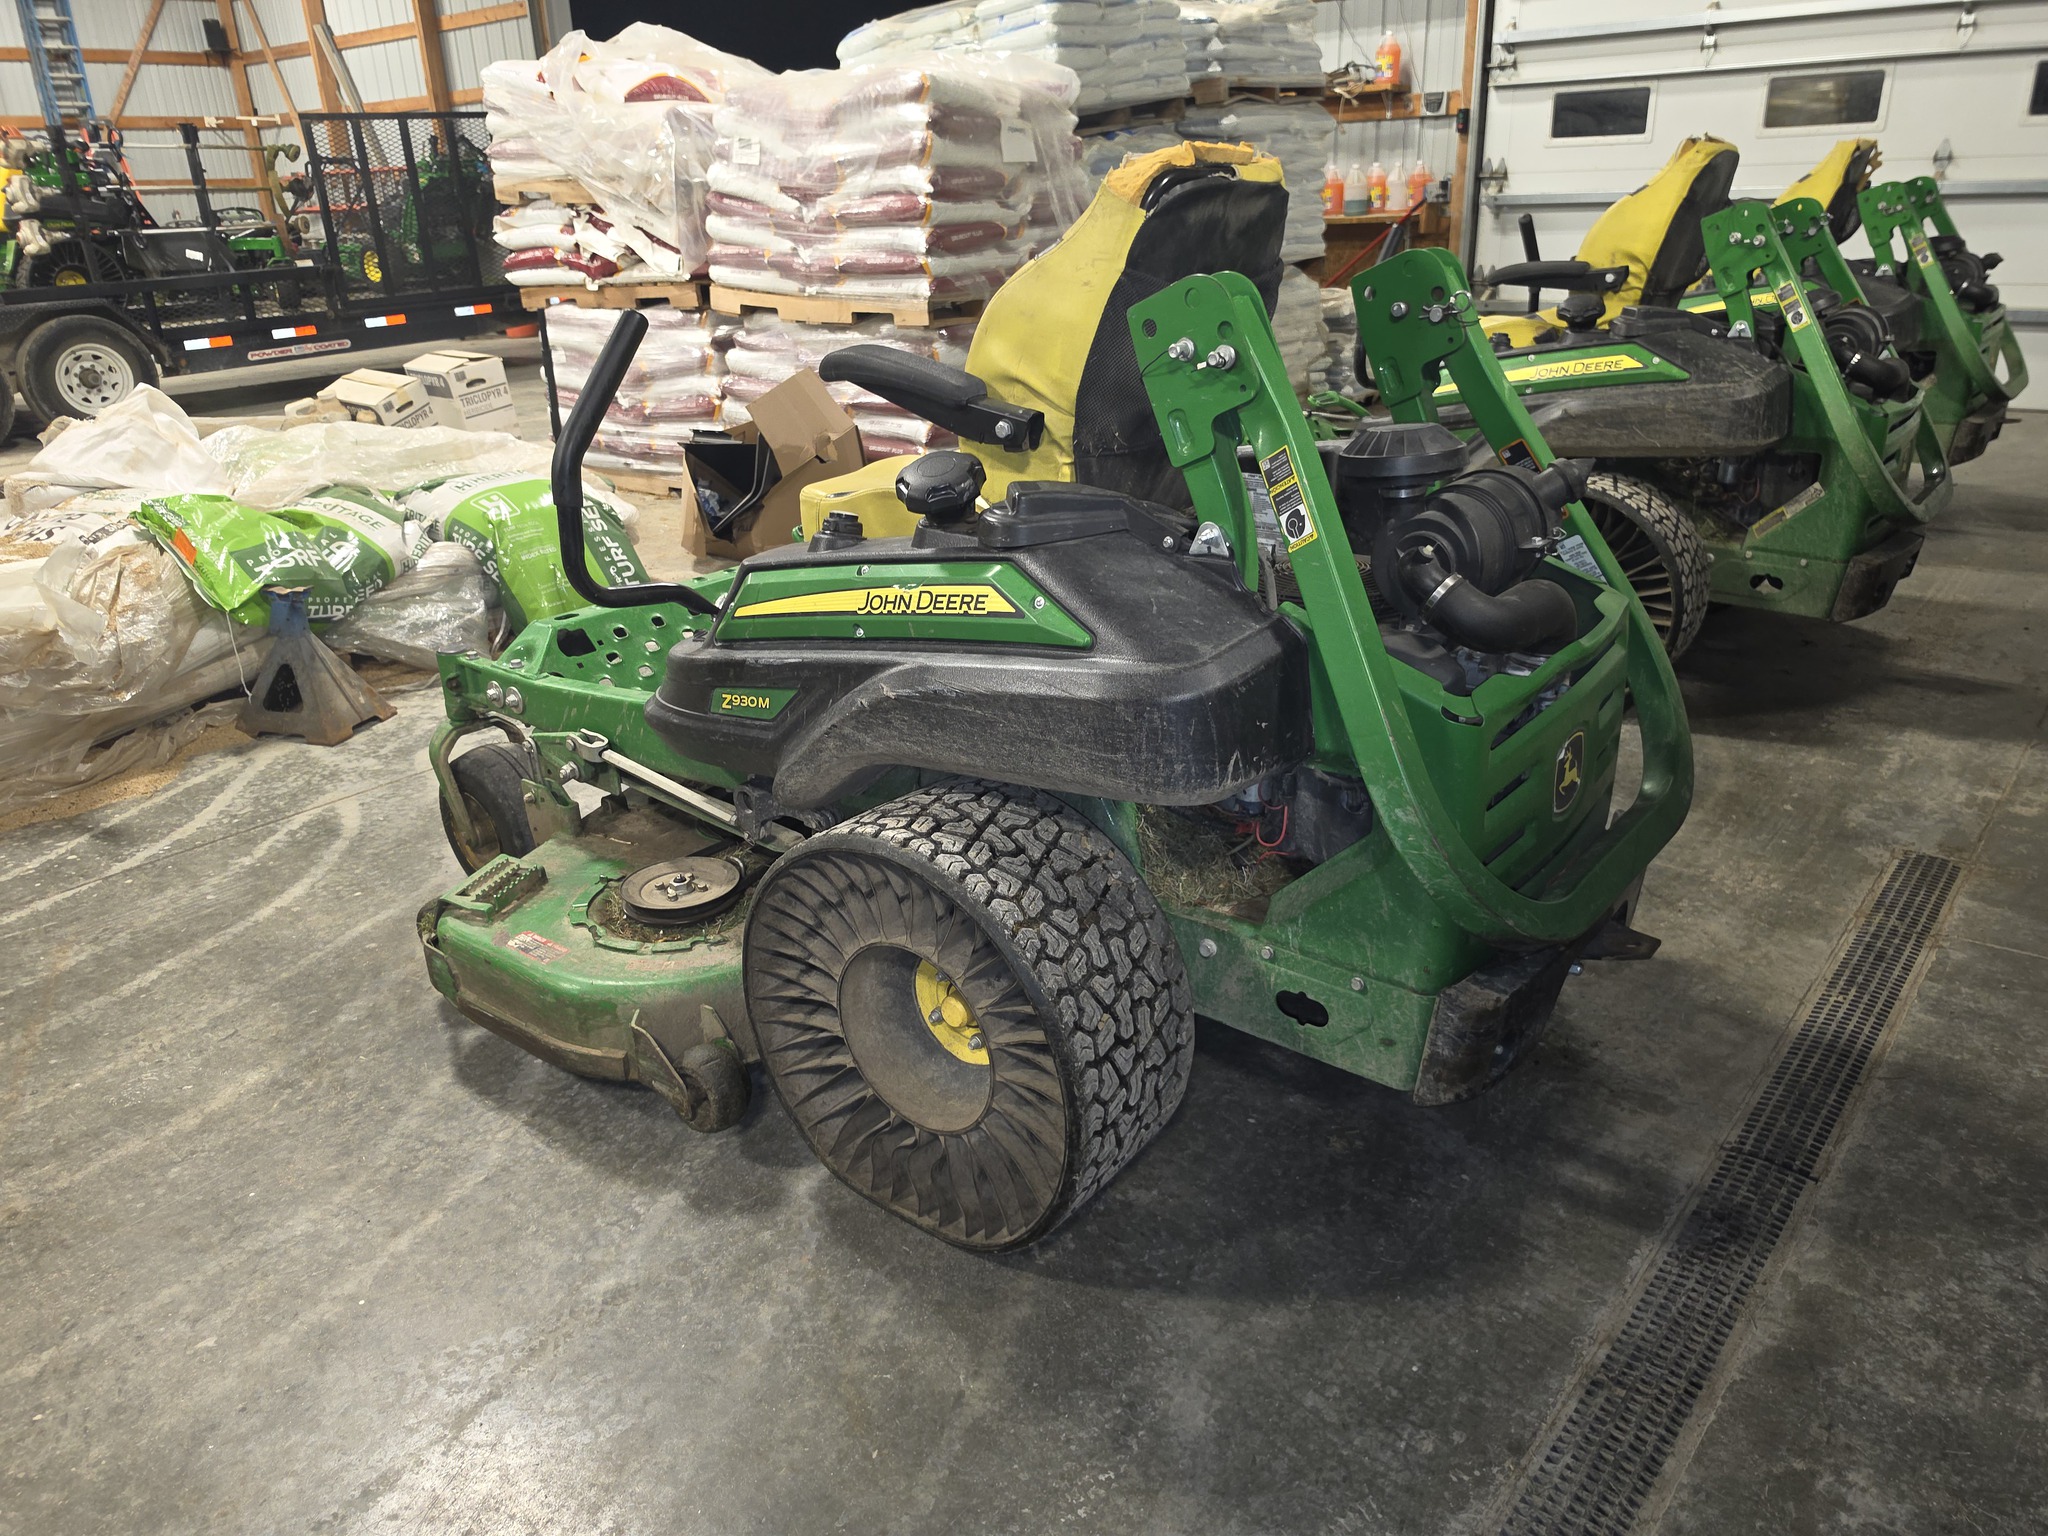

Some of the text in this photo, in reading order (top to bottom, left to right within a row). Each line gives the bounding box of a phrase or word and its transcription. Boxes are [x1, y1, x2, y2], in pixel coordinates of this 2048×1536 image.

[250, 349, 293, 359] POWDER
[314, 341, 349, 350] COATED
[1530, 359, 1624, 379] JOHN DEERE
[460, 386, 509, 408] TRICLOPYR 4
[868, 445, 891, 453] GRUBOUT
[1289, 535, 1311, 551] CAUTION
[600, 535, 641, 586] TURF
[857, 590, 989, 611] JOHN DEERE
[721, 693, 770, 709] Z930M
